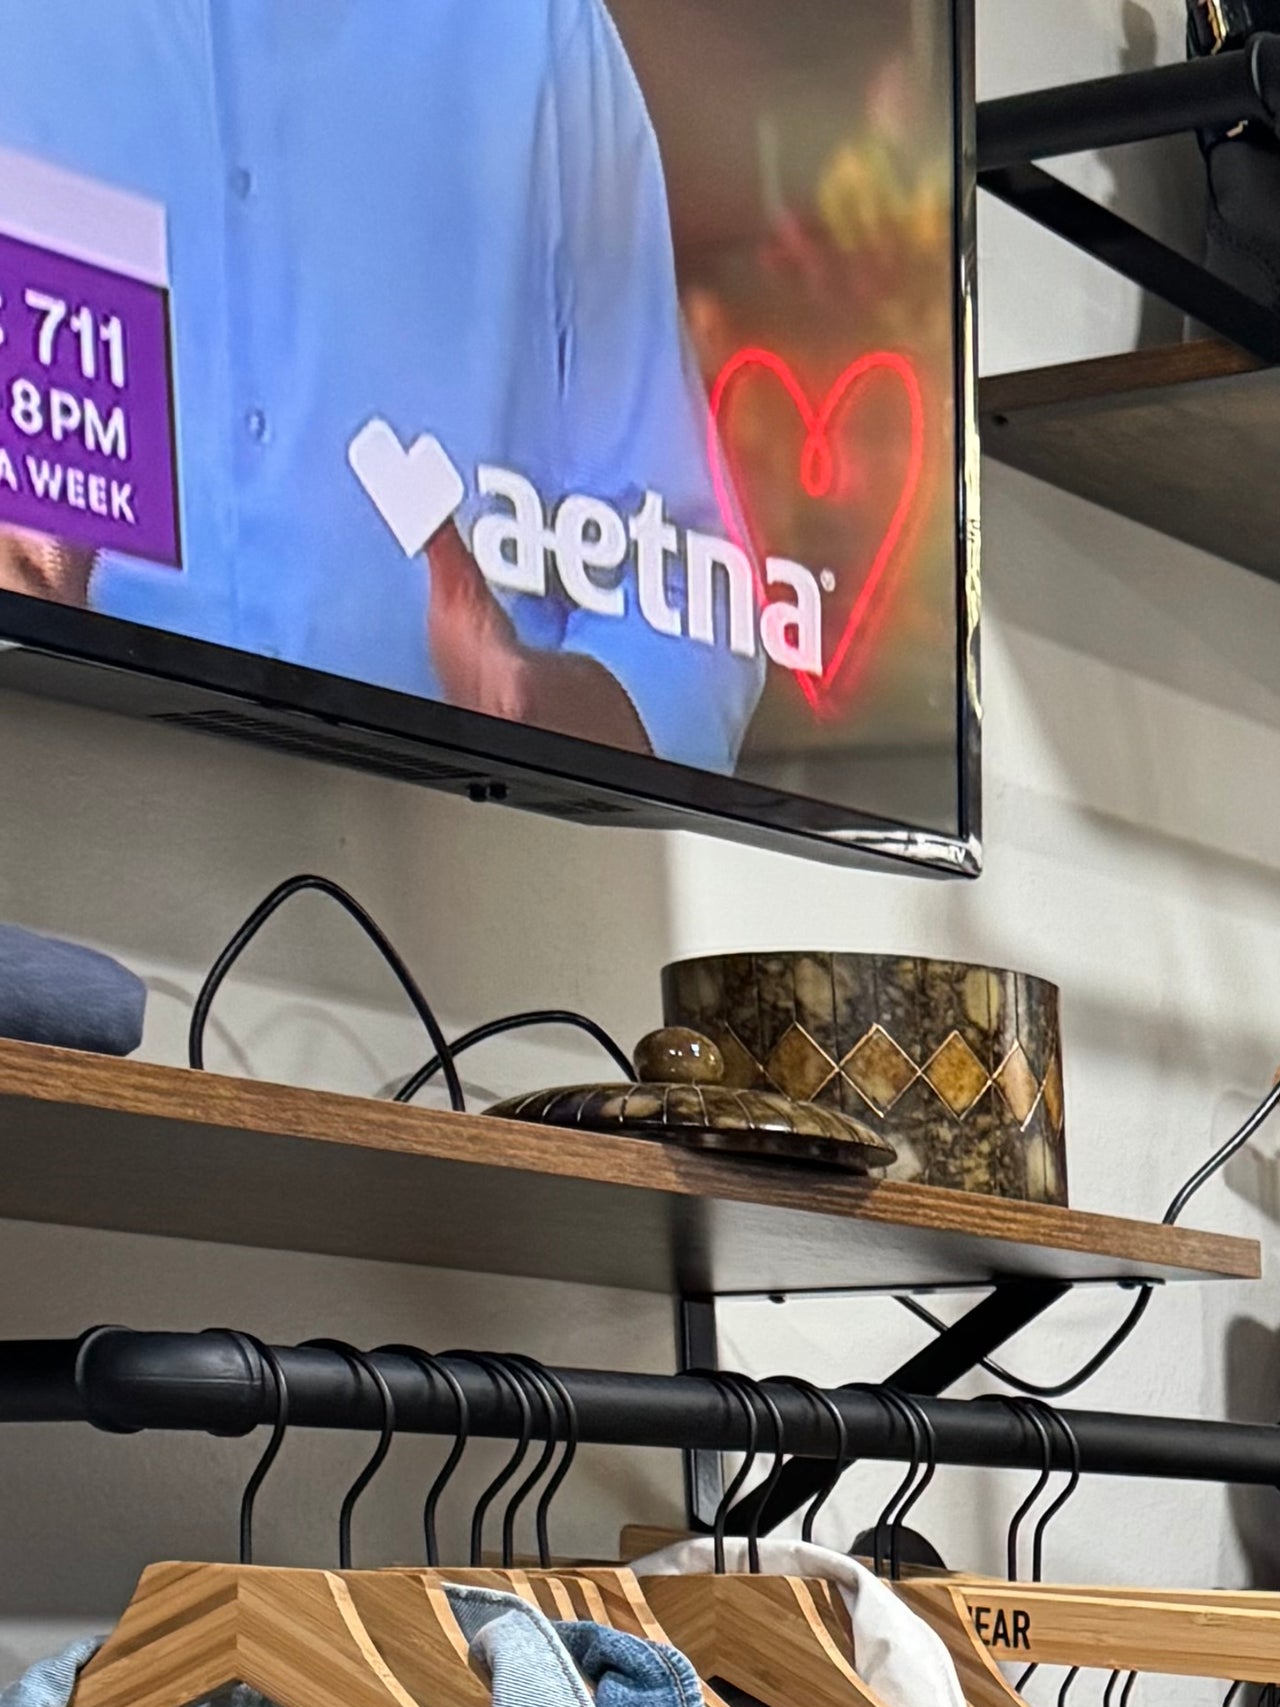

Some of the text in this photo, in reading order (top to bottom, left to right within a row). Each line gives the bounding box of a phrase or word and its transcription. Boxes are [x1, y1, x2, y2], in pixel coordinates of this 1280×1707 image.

[24, 287, 125, 389] 711
[10, 377, 127, 461] 8PM
[25, 453, 136, 524] WEEK
[472, 463, 823, 677] aetna
